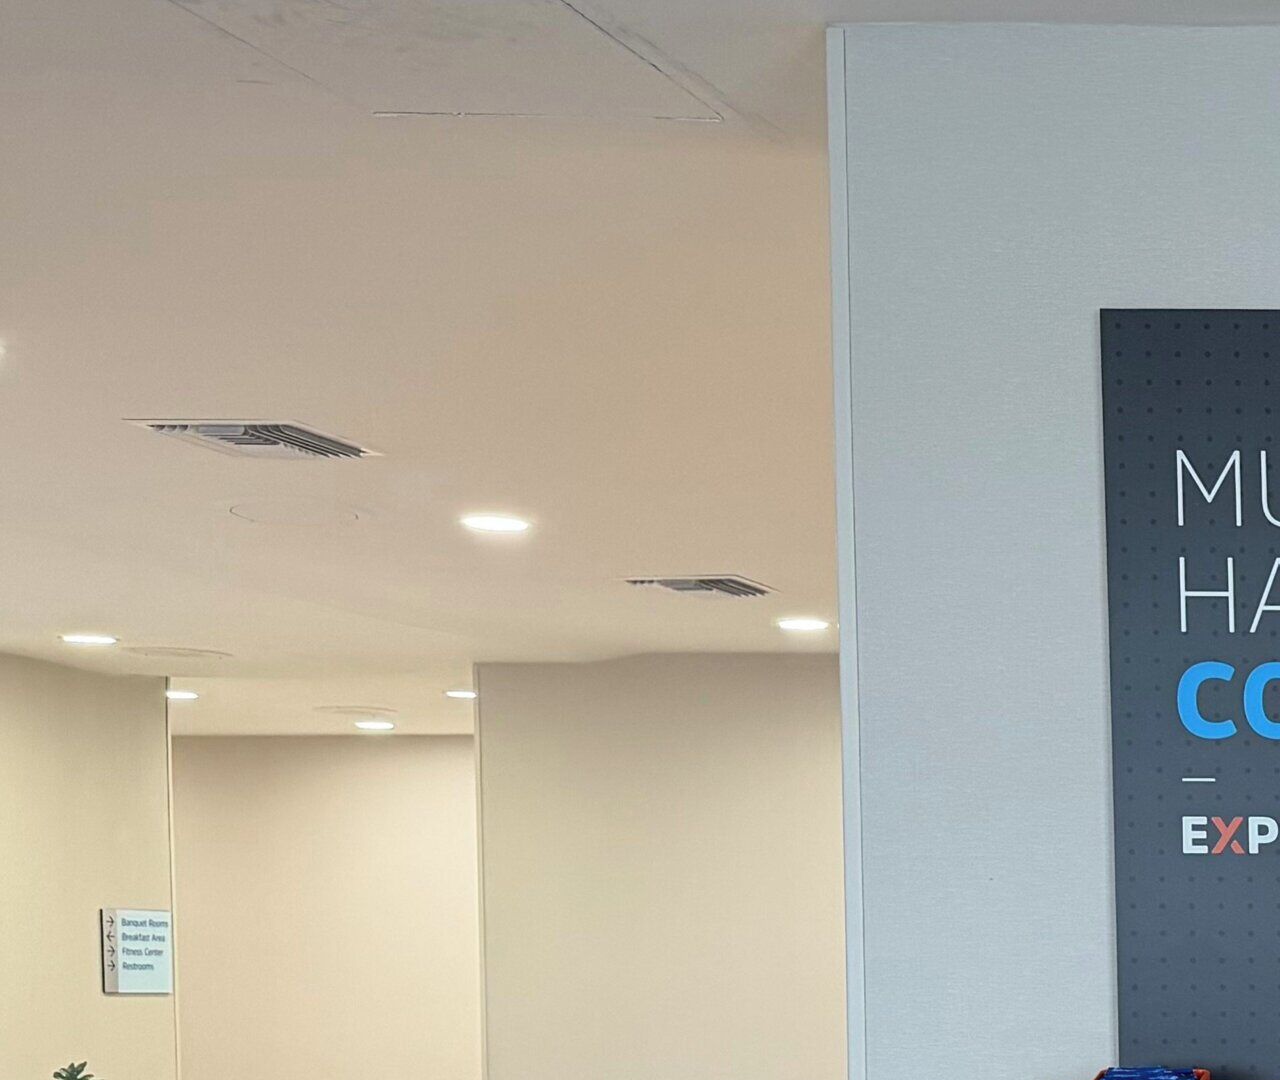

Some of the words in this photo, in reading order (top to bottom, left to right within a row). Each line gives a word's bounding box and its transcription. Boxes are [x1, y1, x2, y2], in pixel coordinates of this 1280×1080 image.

[122, 918, 147, 928] Banquet
[150, 920, 169, 928] Rooms
[122, 932, 150, 942] Breakfast
[152, 934, 166, 942] Area
[122, 948, 143, 956] Fitness
[144, 948, 164, 956] Center
[122, 962, 155, 970] Restrooms
